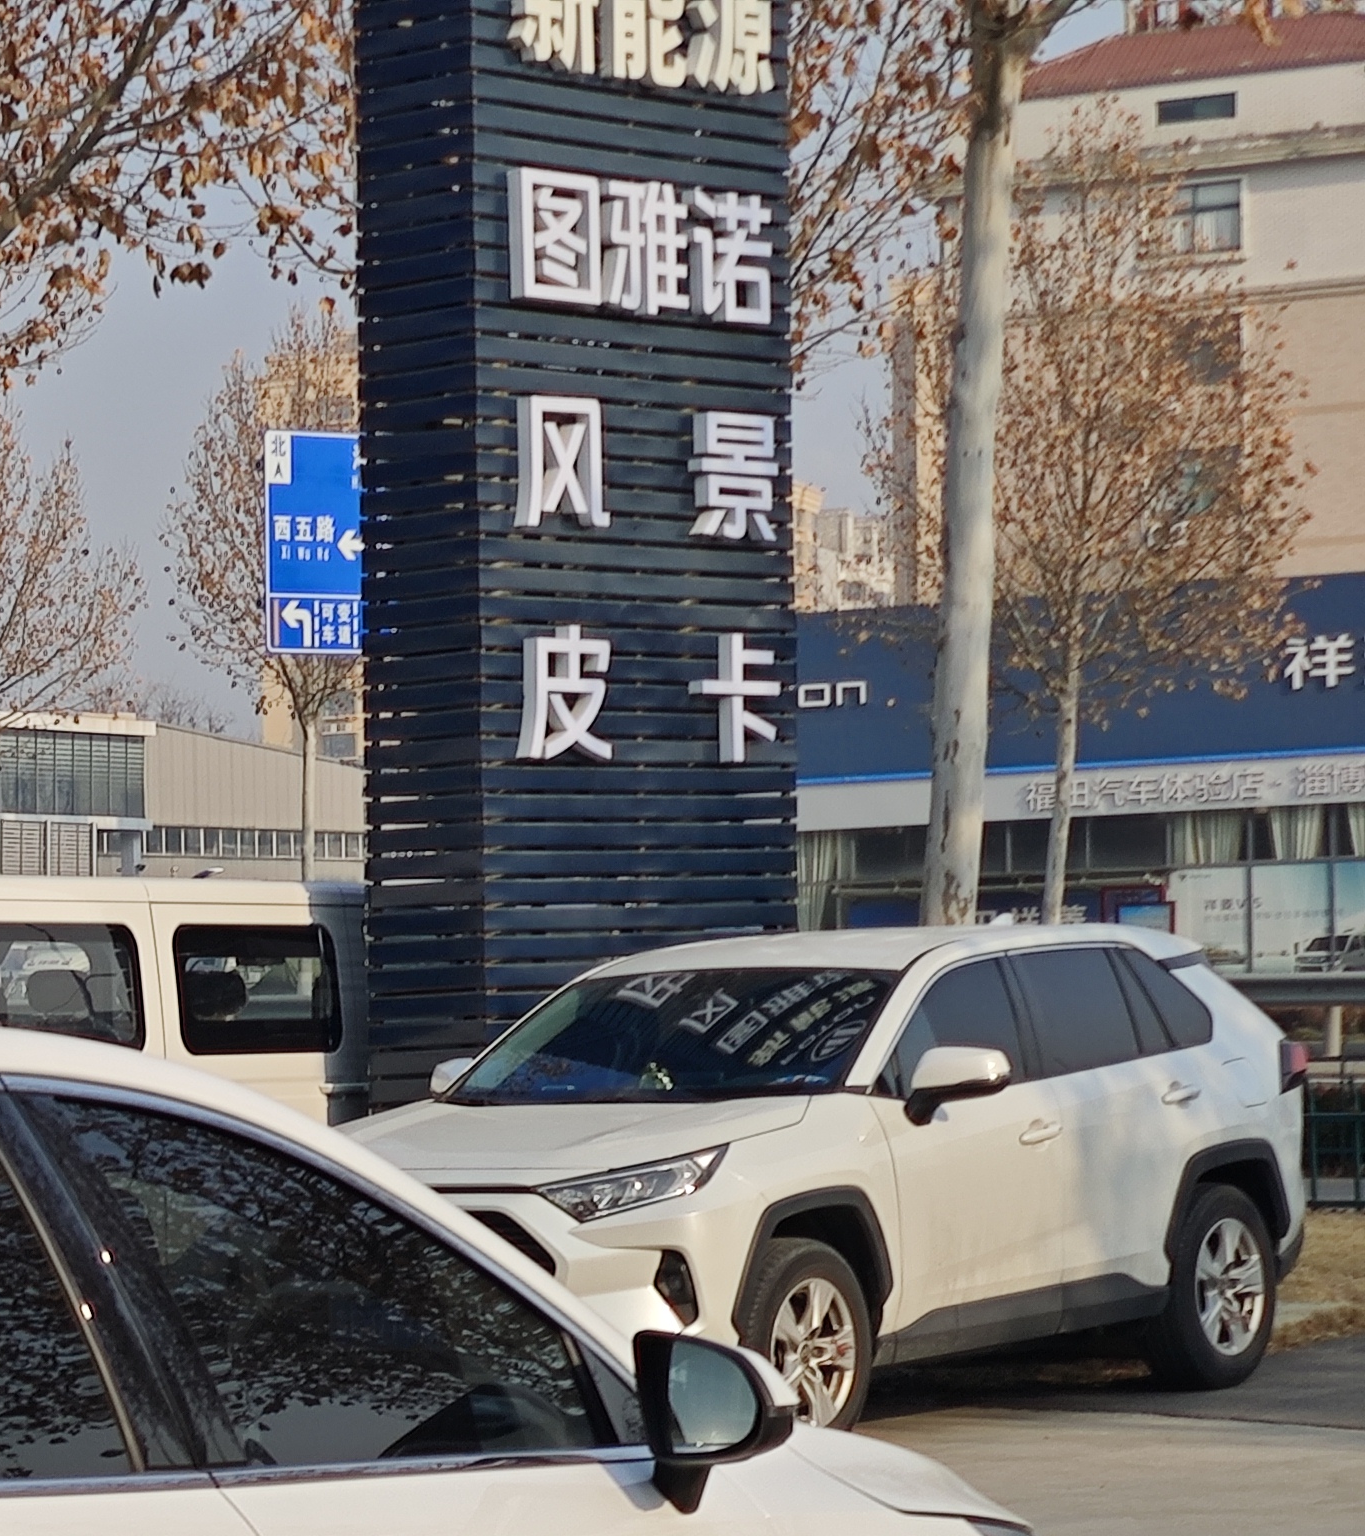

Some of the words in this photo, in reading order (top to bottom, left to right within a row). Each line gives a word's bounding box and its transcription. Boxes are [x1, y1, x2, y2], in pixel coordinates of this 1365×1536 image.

[507, 166, 772, 324] 图雅诺
[271, 434, 287, 458] 北
[273, 515, 335, 543] 西五路
